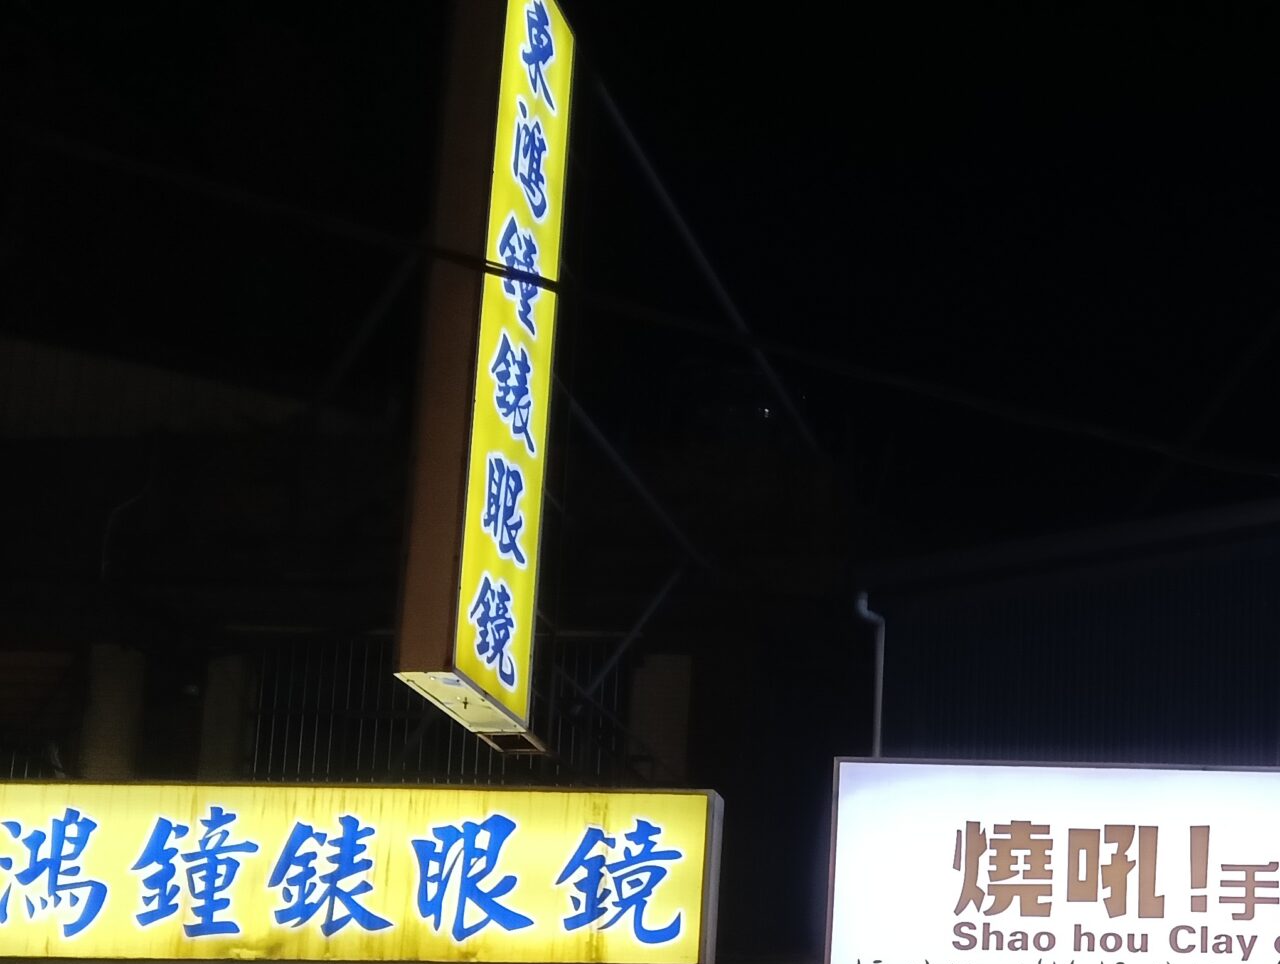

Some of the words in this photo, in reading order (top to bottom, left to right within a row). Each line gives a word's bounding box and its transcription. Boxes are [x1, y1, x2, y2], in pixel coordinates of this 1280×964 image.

[952, 921, 1057, 954] Shao
[1073, 924, 1150, 955] hou
[1168, 925, 1258, 962] Clay
